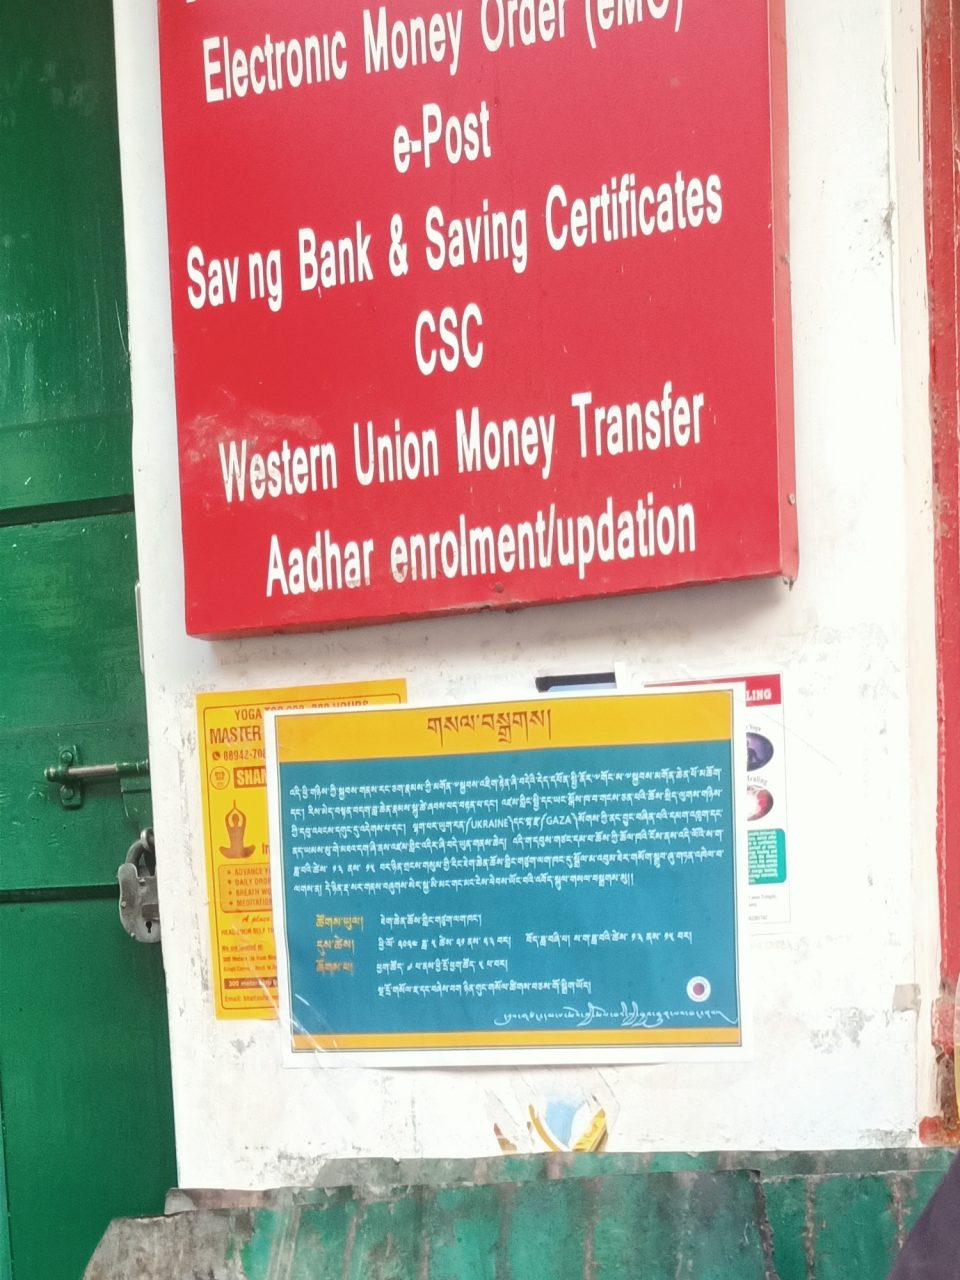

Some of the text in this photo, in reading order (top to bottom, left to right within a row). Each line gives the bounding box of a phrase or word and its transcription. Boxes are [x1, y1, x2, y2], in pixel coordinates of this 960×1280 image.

[203, 31, 347, 103] Electronic
[363, 6, 462, 75] Money
[481, 0, 565, 52] Order
[393, 102, 491, 172] e-Post
[187, 172, 723, 312] Savng Bank & Saving Certificates
[415, 303, 484, 375] CSC
[219, 381, 704, 502] Western Union Money Transfer
[266, 501, 696, 596] Aadhar enrolment/updation
[210, 725, 262, 744] MASTER
[235, 708, 262, 721] YOGA
